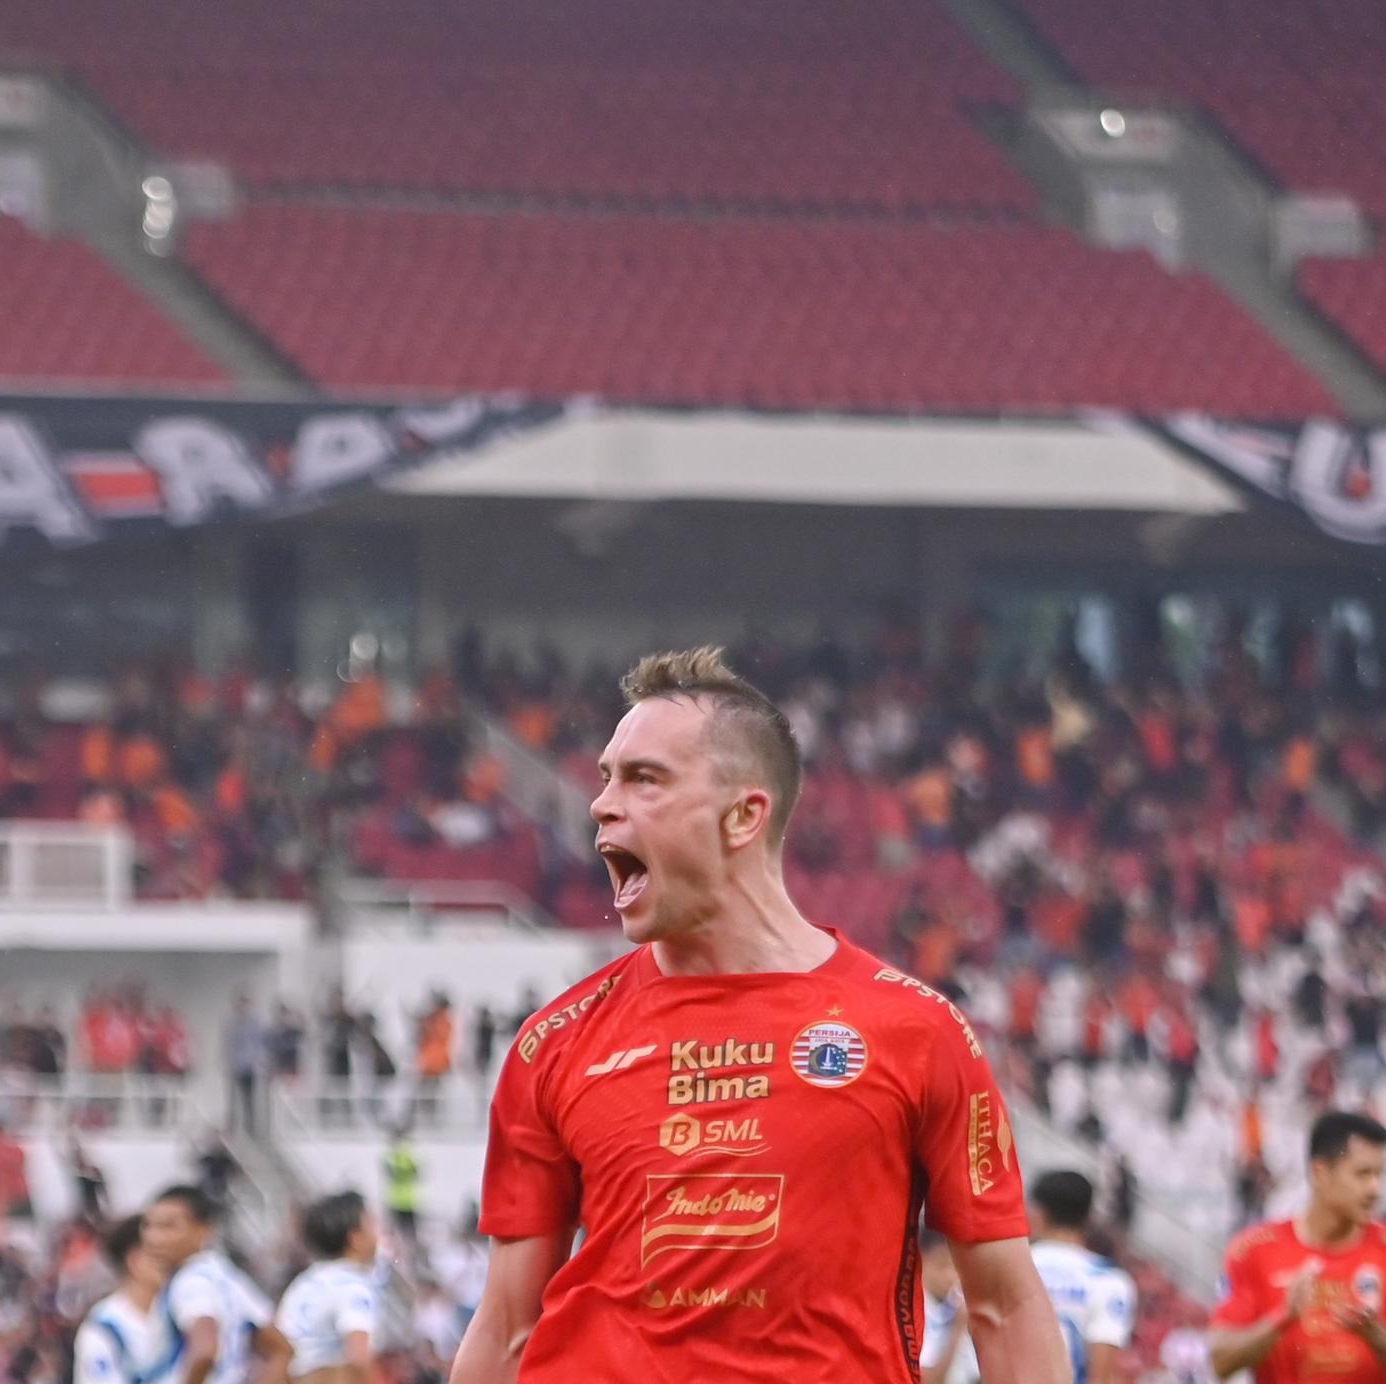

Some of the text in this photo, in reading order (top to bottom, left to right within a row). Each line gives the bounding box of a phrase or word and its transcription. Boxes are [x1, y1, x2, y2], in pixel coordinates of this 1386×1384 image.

[808, 1029, 851, 1037] PERSIJA
[670, 1037, 775, 1071] Kuku
[667, 1071, 770, 1105] Bima
[702, 1117, 764, 1143] SML
[977, 1089, 995, 1194] ITHACA
[668, 1287, 767, 1309] AMMAN
